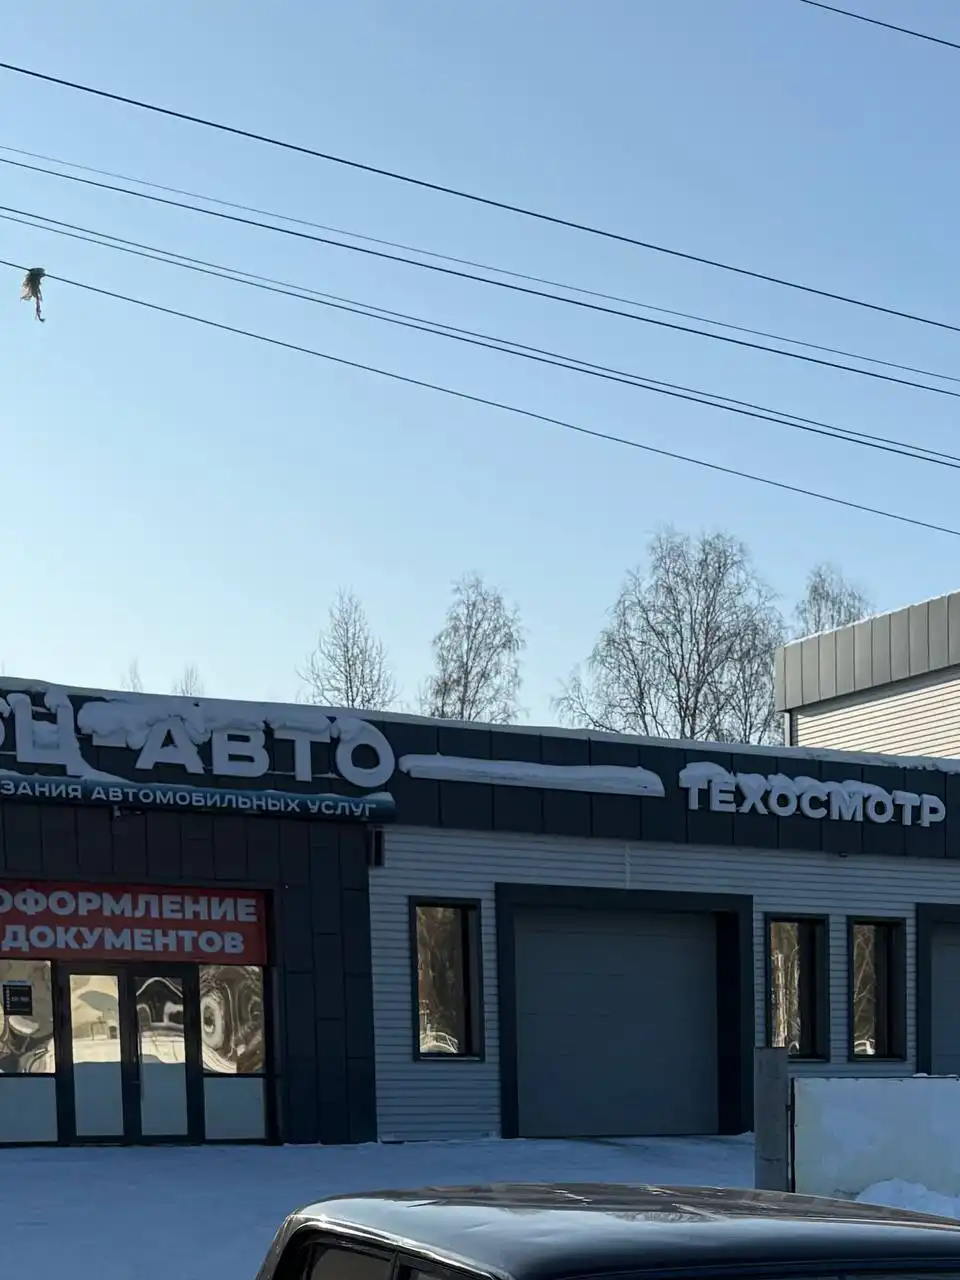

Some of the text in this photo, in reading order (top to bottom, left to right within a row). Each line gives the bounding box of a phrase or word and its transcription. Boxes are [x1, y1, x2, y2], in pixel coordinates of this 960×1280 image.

[0, 693, 395, 787] Ц-АВТО
[91, 786, 300, 813] АВТОМОБИЛЬНЫХ
[308, 799, 377, 818] УСЛУГ
[679, 774, 946, 828] ТЕХОСМОТР
[1, 924, 245, 954] ДОКУМЕНТОВ
